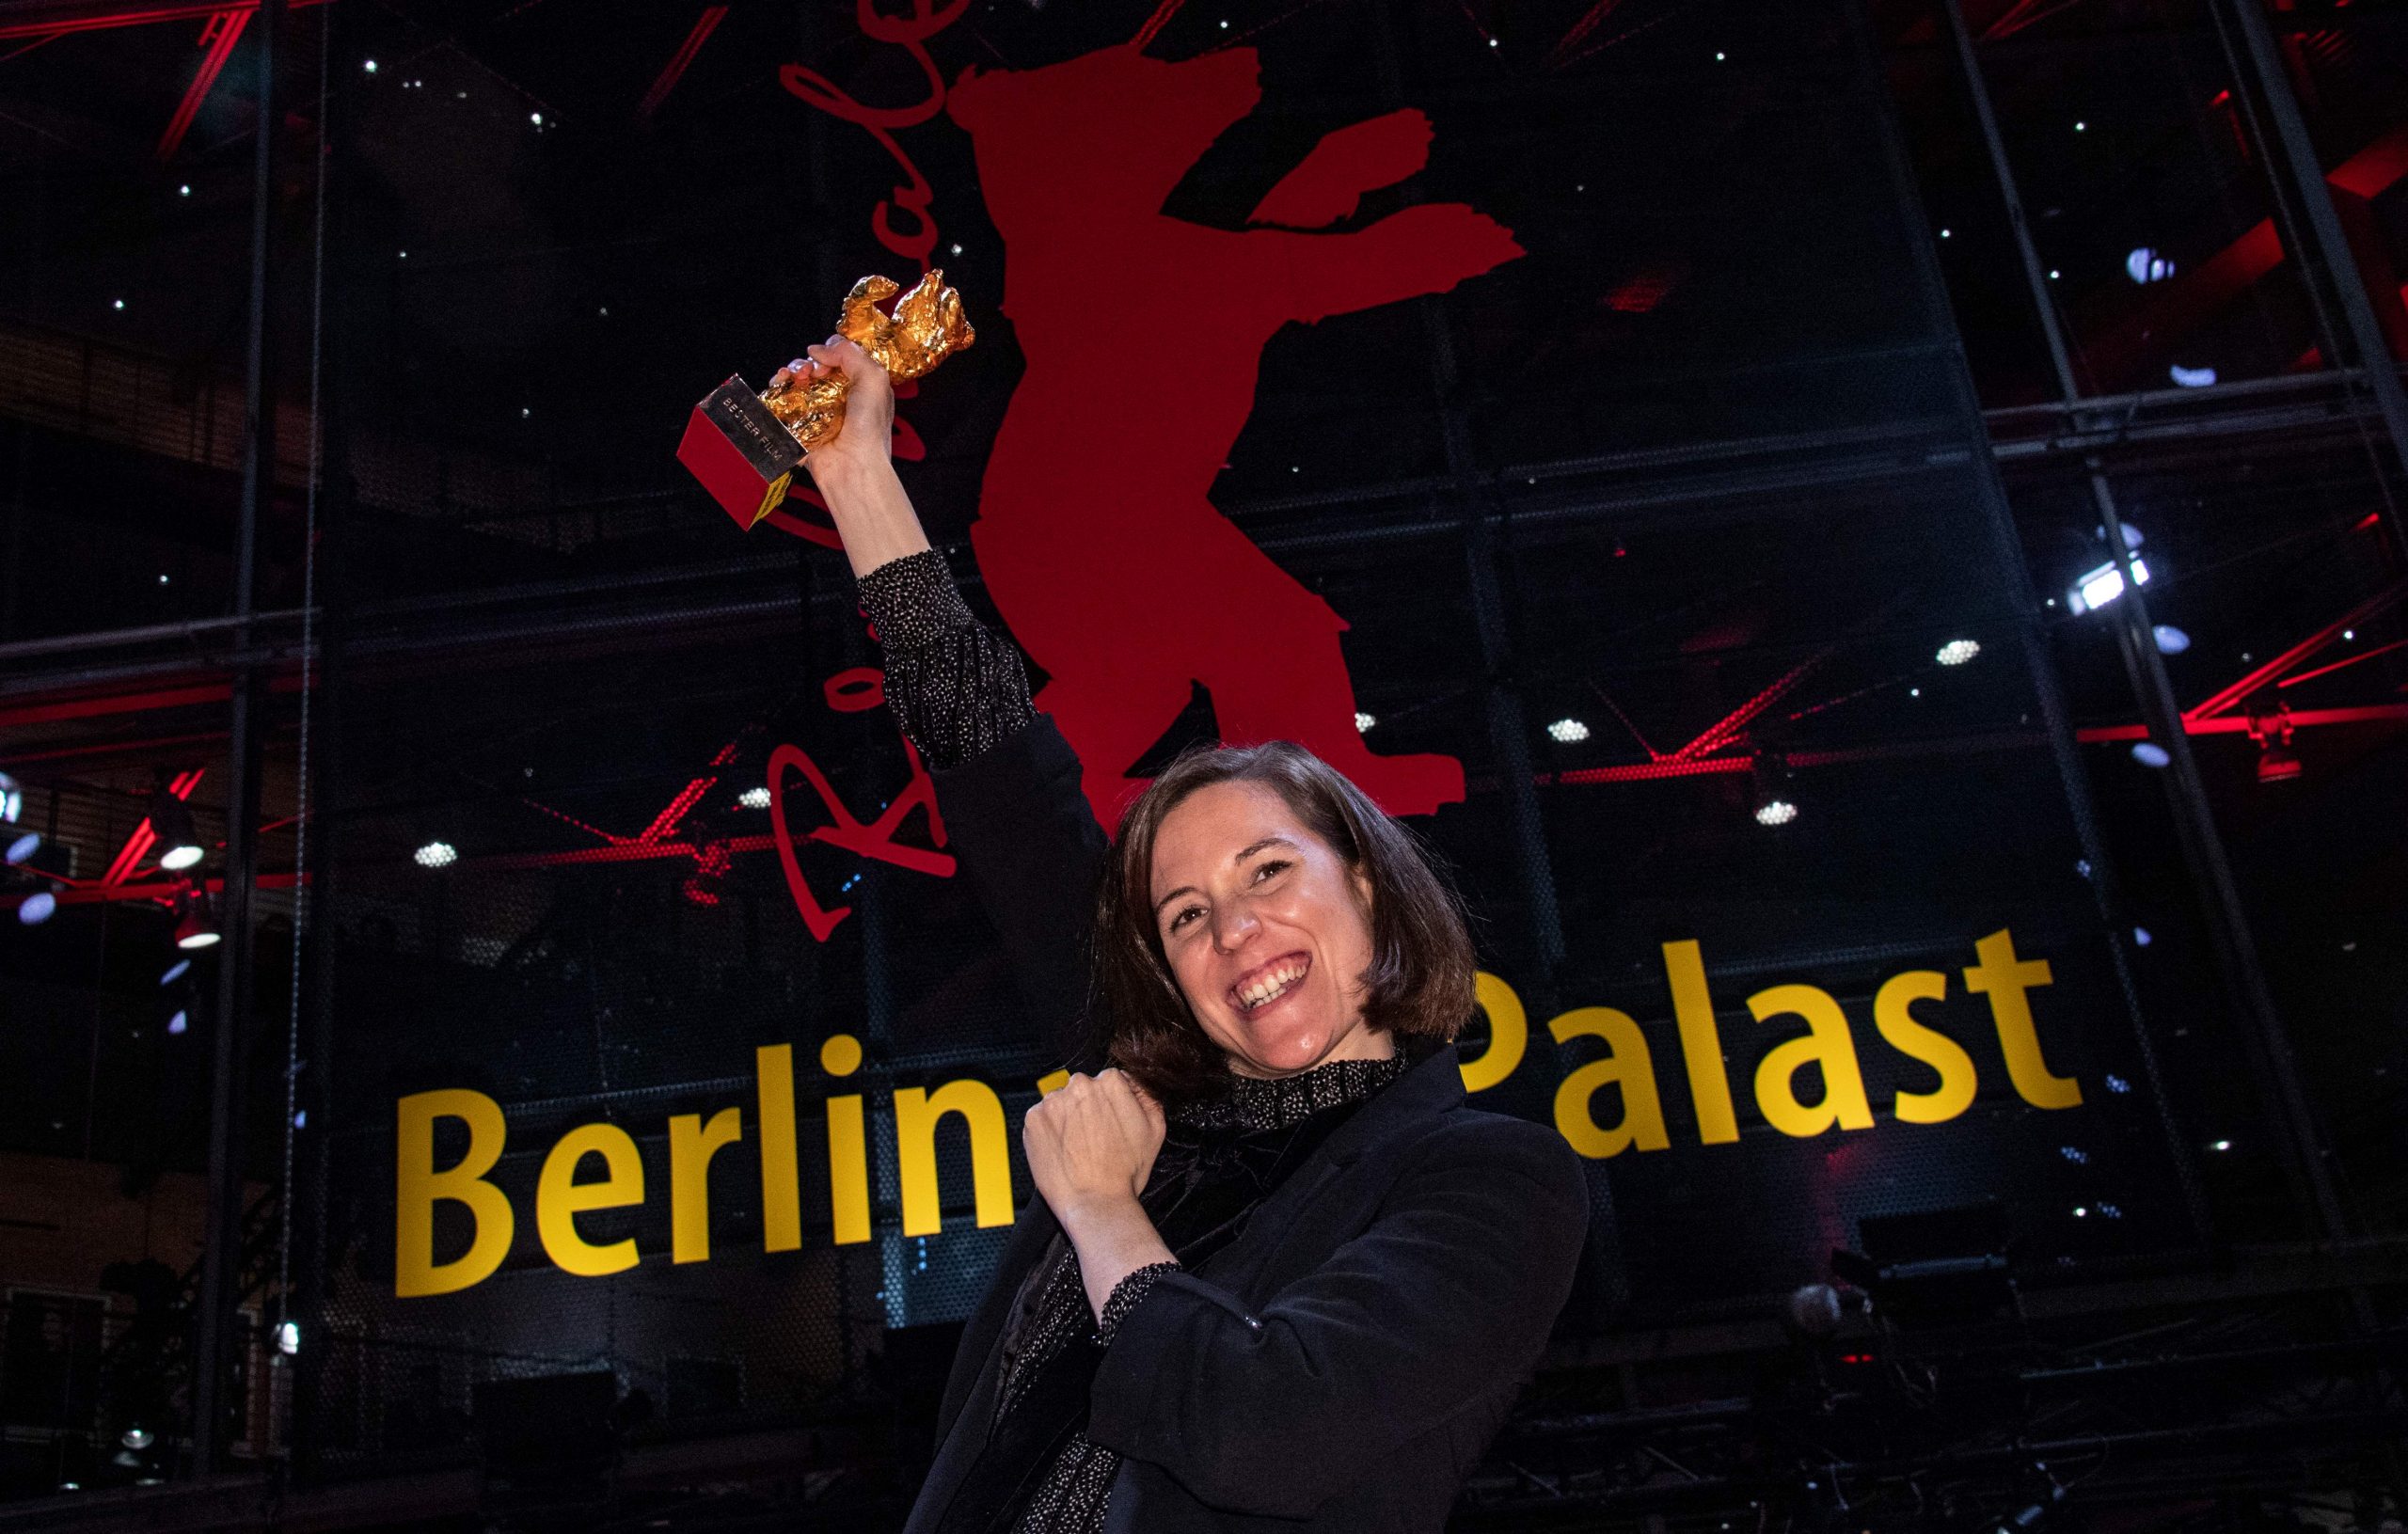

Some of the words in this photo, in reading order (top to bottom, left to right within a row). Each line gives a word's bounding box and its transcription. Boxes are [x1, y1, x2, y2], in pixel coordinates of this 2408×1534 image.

[722, 397, 760, 436] BESTER
[758, 435, 783, 461] FILM
[765, 0, 973, 943] Beale
[397, 1035, 1071, 1297] Berlin
